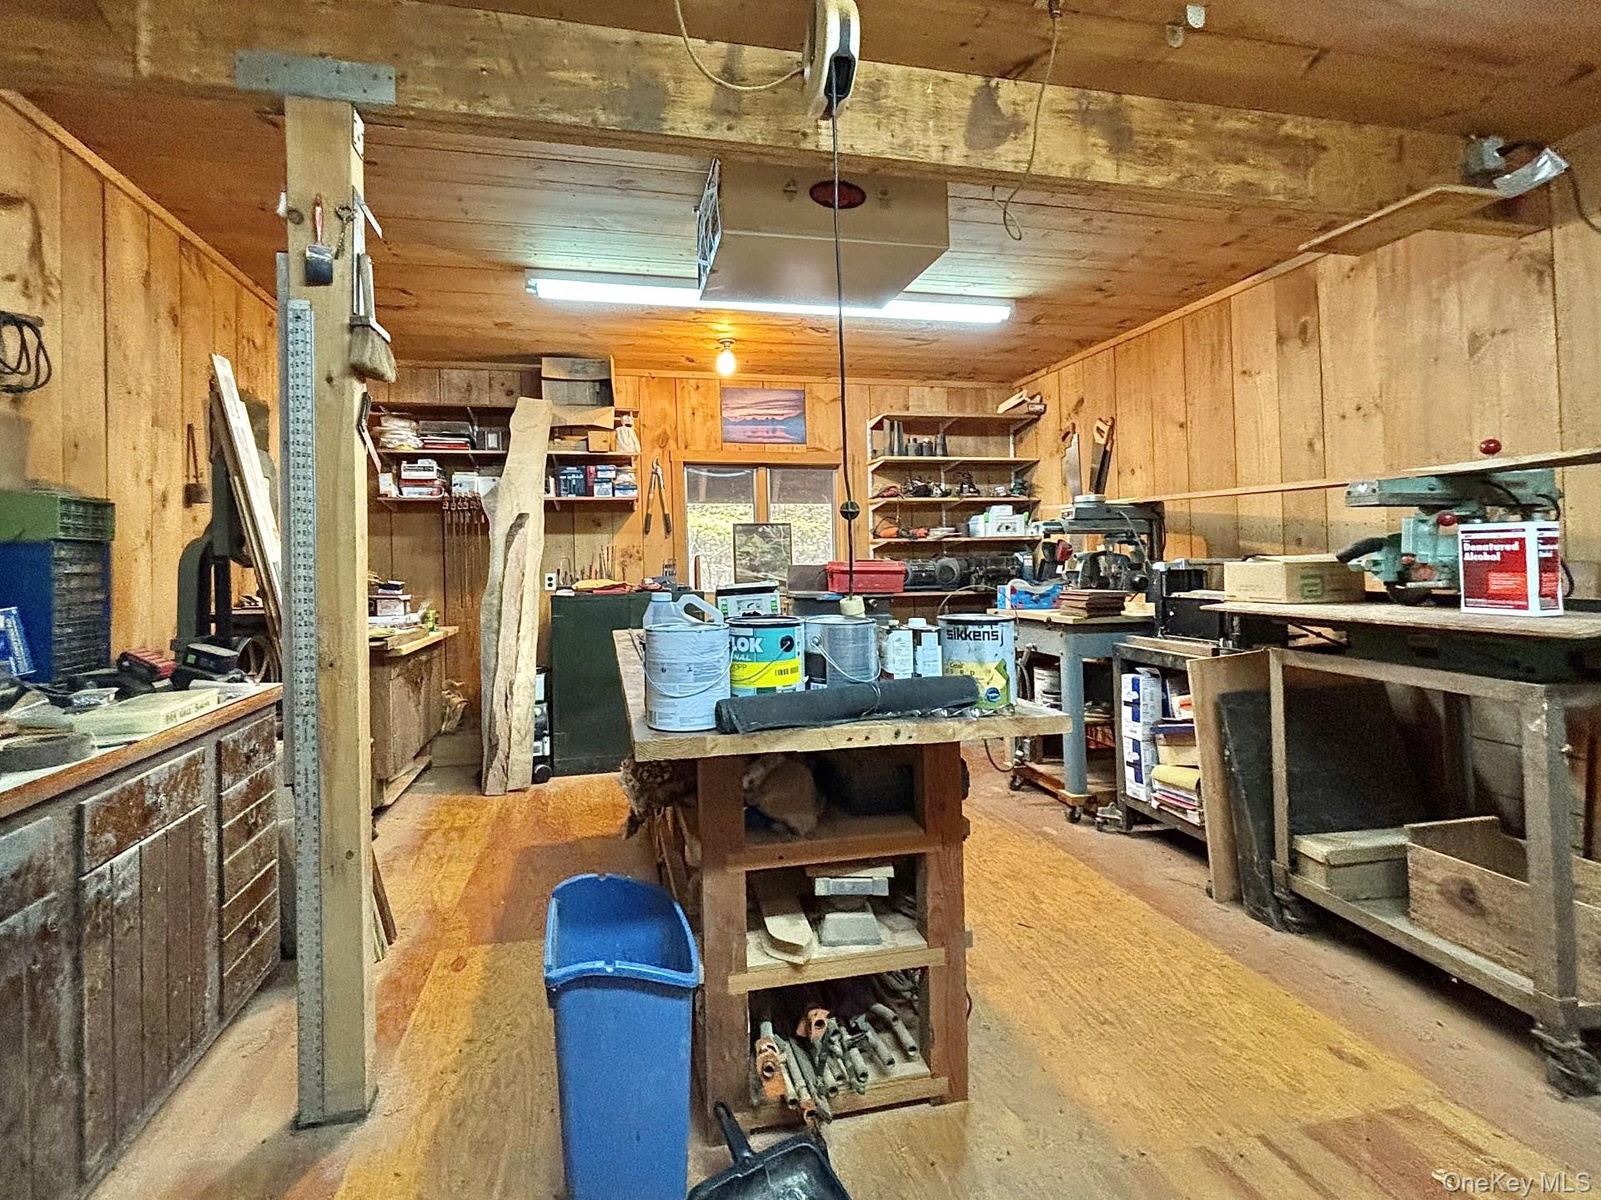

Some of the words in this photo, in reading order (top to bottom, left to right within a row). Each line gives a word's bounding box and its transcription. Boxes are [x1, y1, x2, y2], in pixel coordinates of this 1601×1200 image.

[1463, 541, 1520, 551] Denatured
[1463, 552, 1501, 561] Alcohol
[946, 627, 999, 641] sikkens
[730, 636, 764, 653] LOK
[733, 653, 752, 661] NAL
